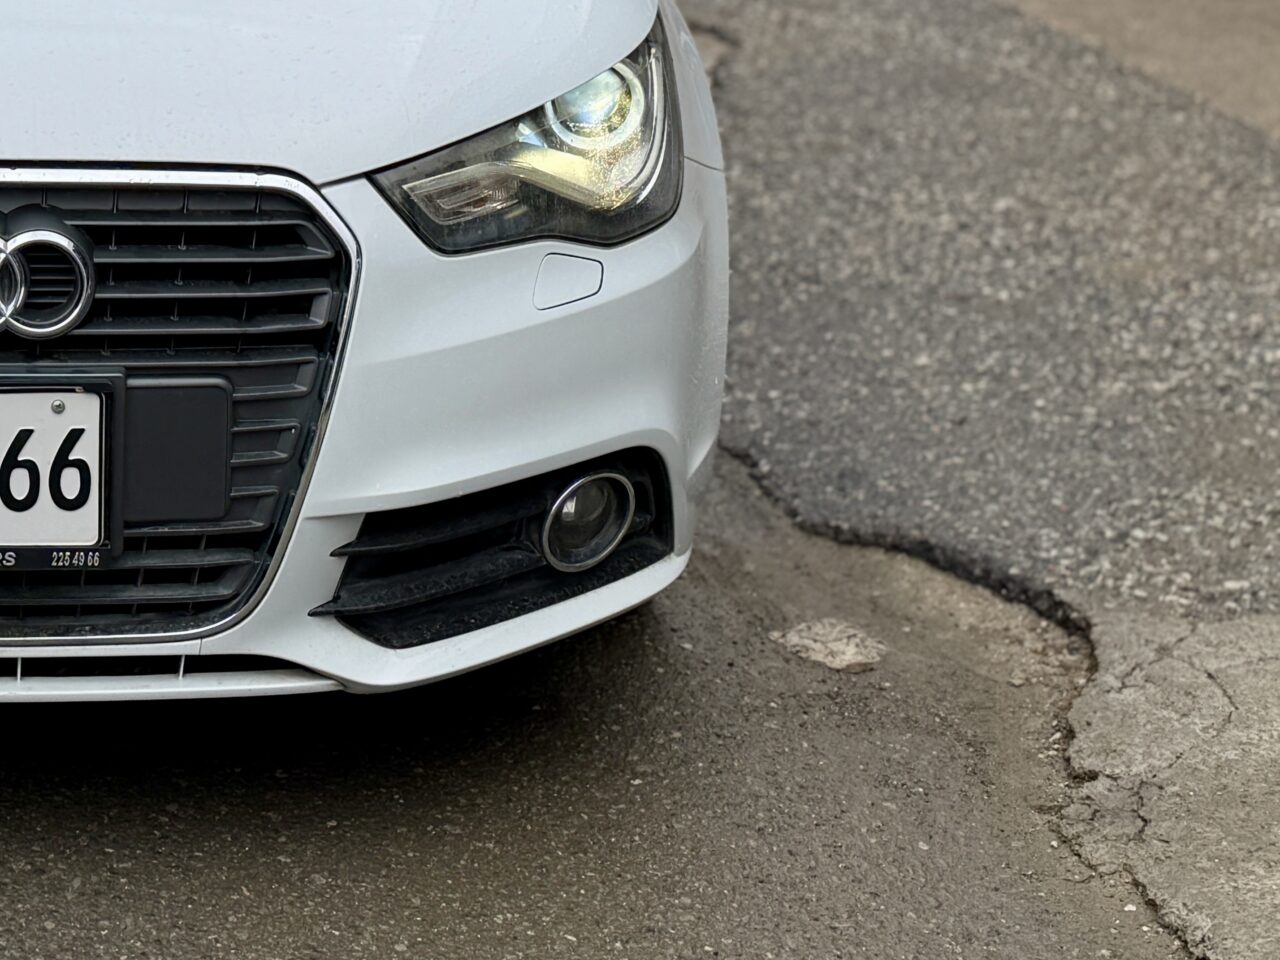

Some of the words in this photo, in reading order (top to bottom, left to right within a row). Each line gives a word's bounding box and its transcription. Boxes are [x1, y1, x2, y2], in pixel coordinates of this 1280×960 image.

[51, 551, 71, 567] 225
[72, 551, 85, 567] 49
[87, 551, 101, 567] 66
